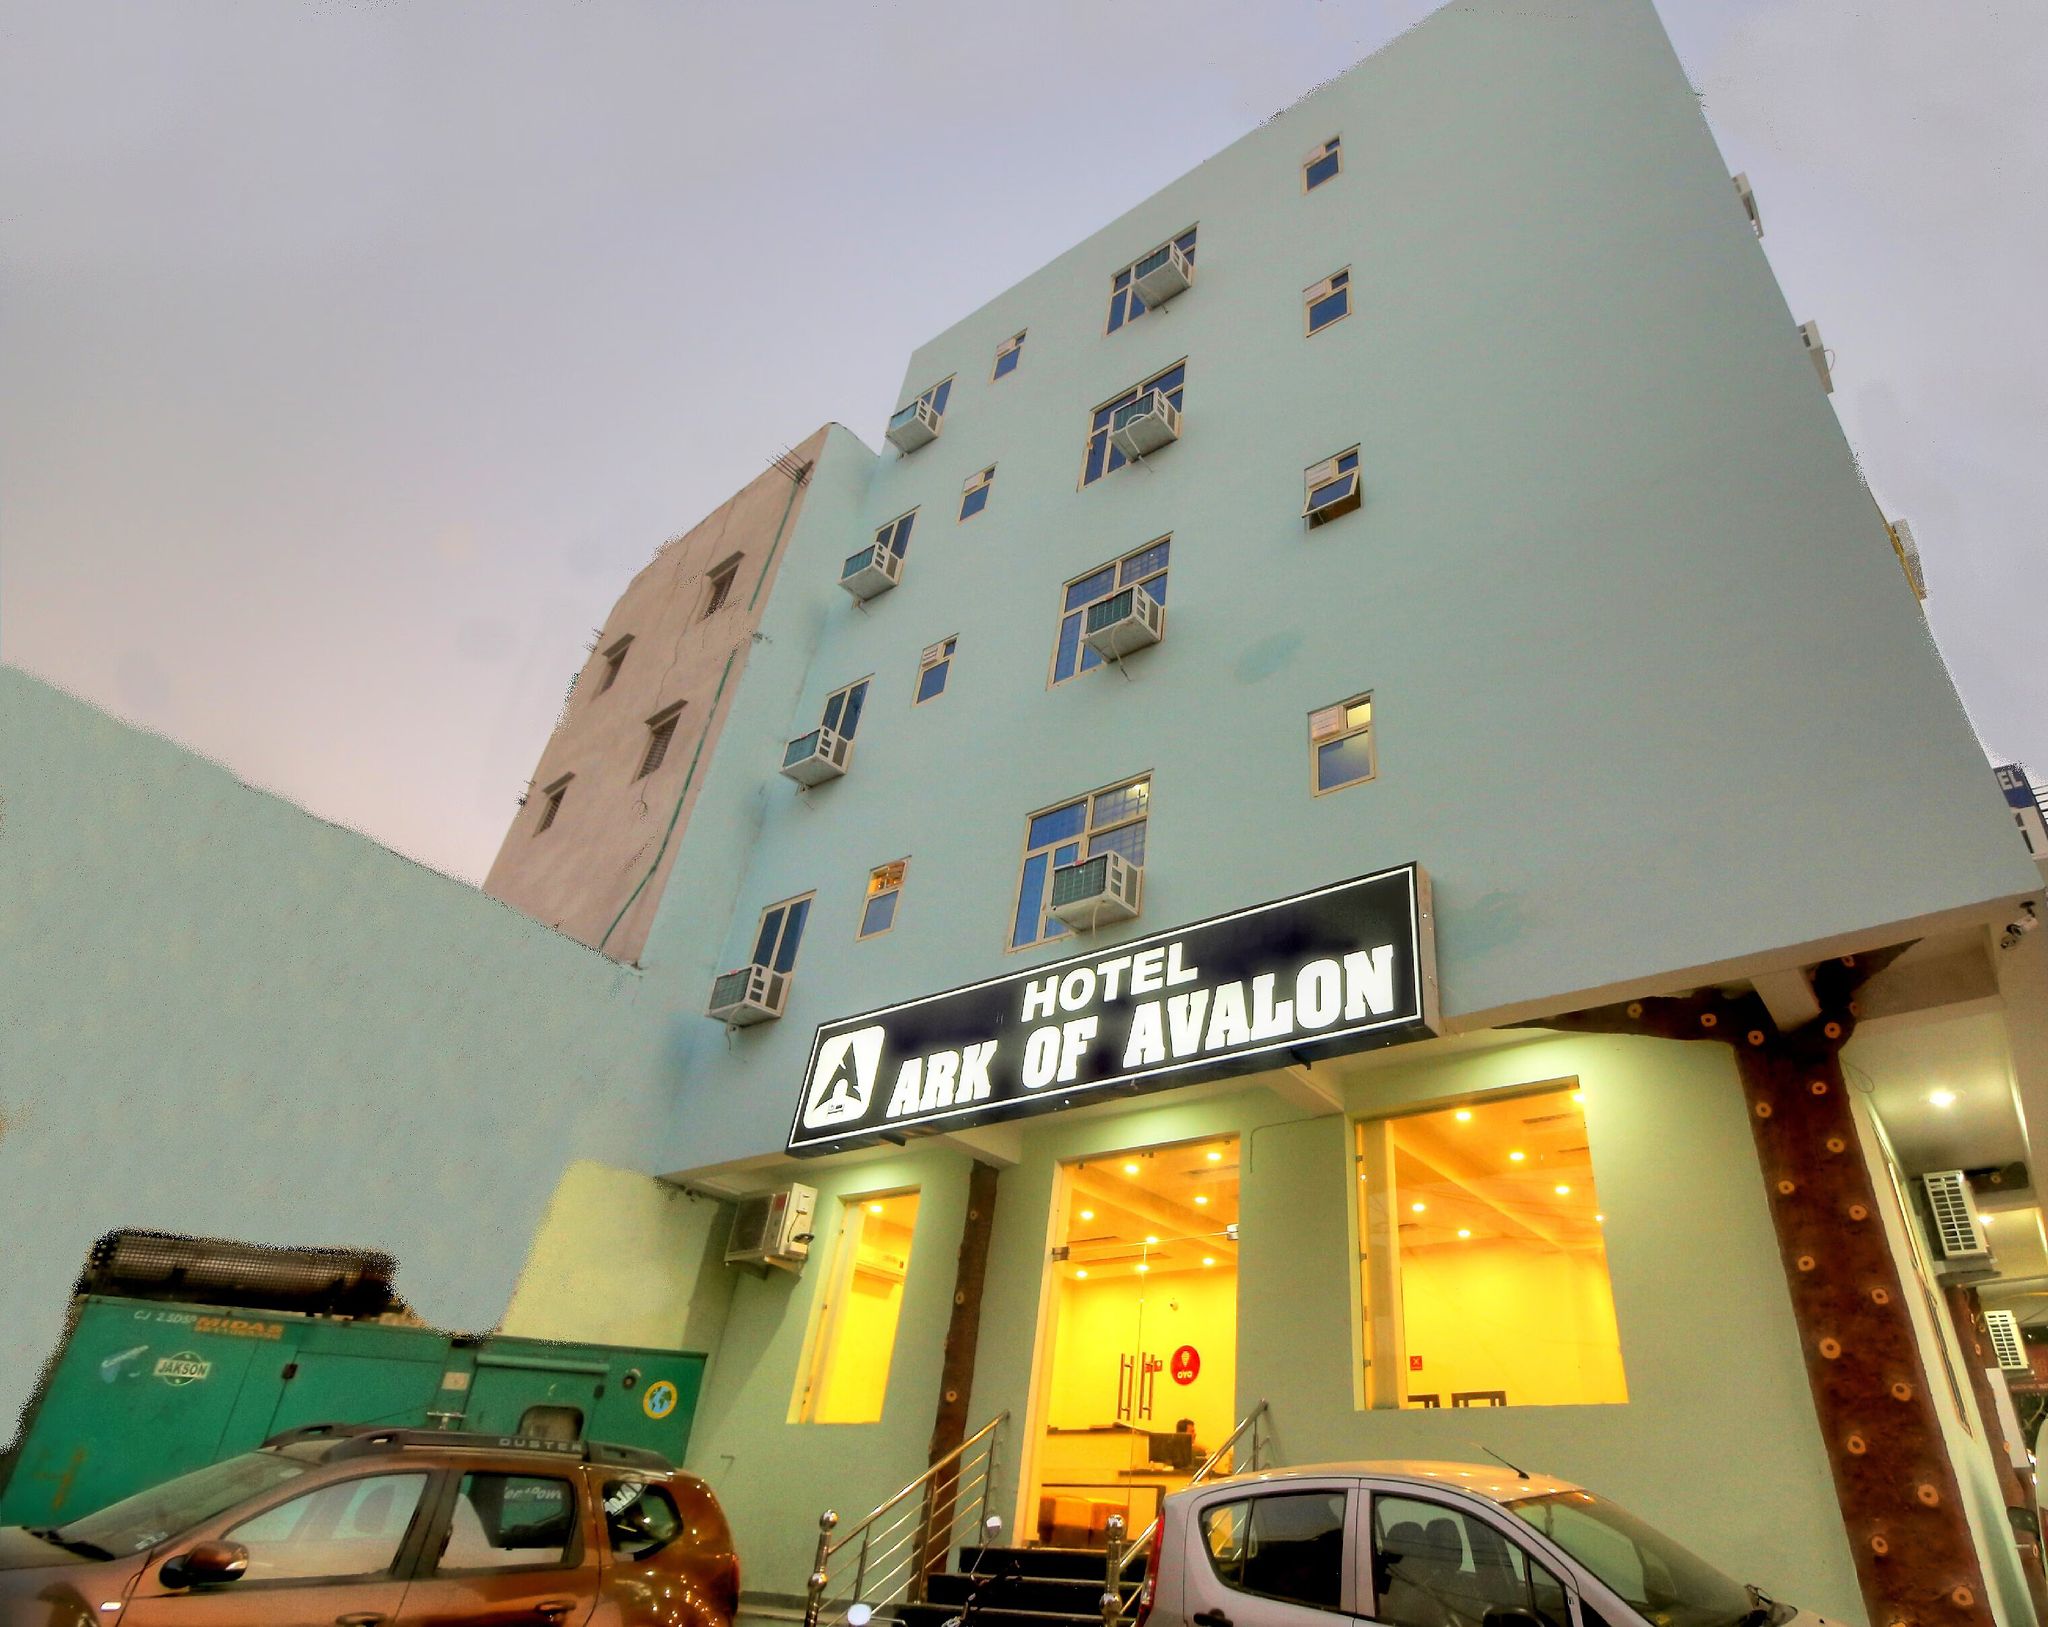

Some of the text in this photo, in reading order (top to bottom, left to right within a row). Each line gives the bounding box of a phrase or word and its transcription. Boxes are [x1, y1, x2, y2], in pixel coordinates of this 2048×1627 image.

[1020, 942, 1200, 1023] HOTEL
[886, 944, 1395, 1119] ARK OF AVALON
[158, 1360, 208, 1376] JAKSON
[1177, 1370, 1193, 1379] OYO
[498, 1437, 583, 1452] DUSTER
